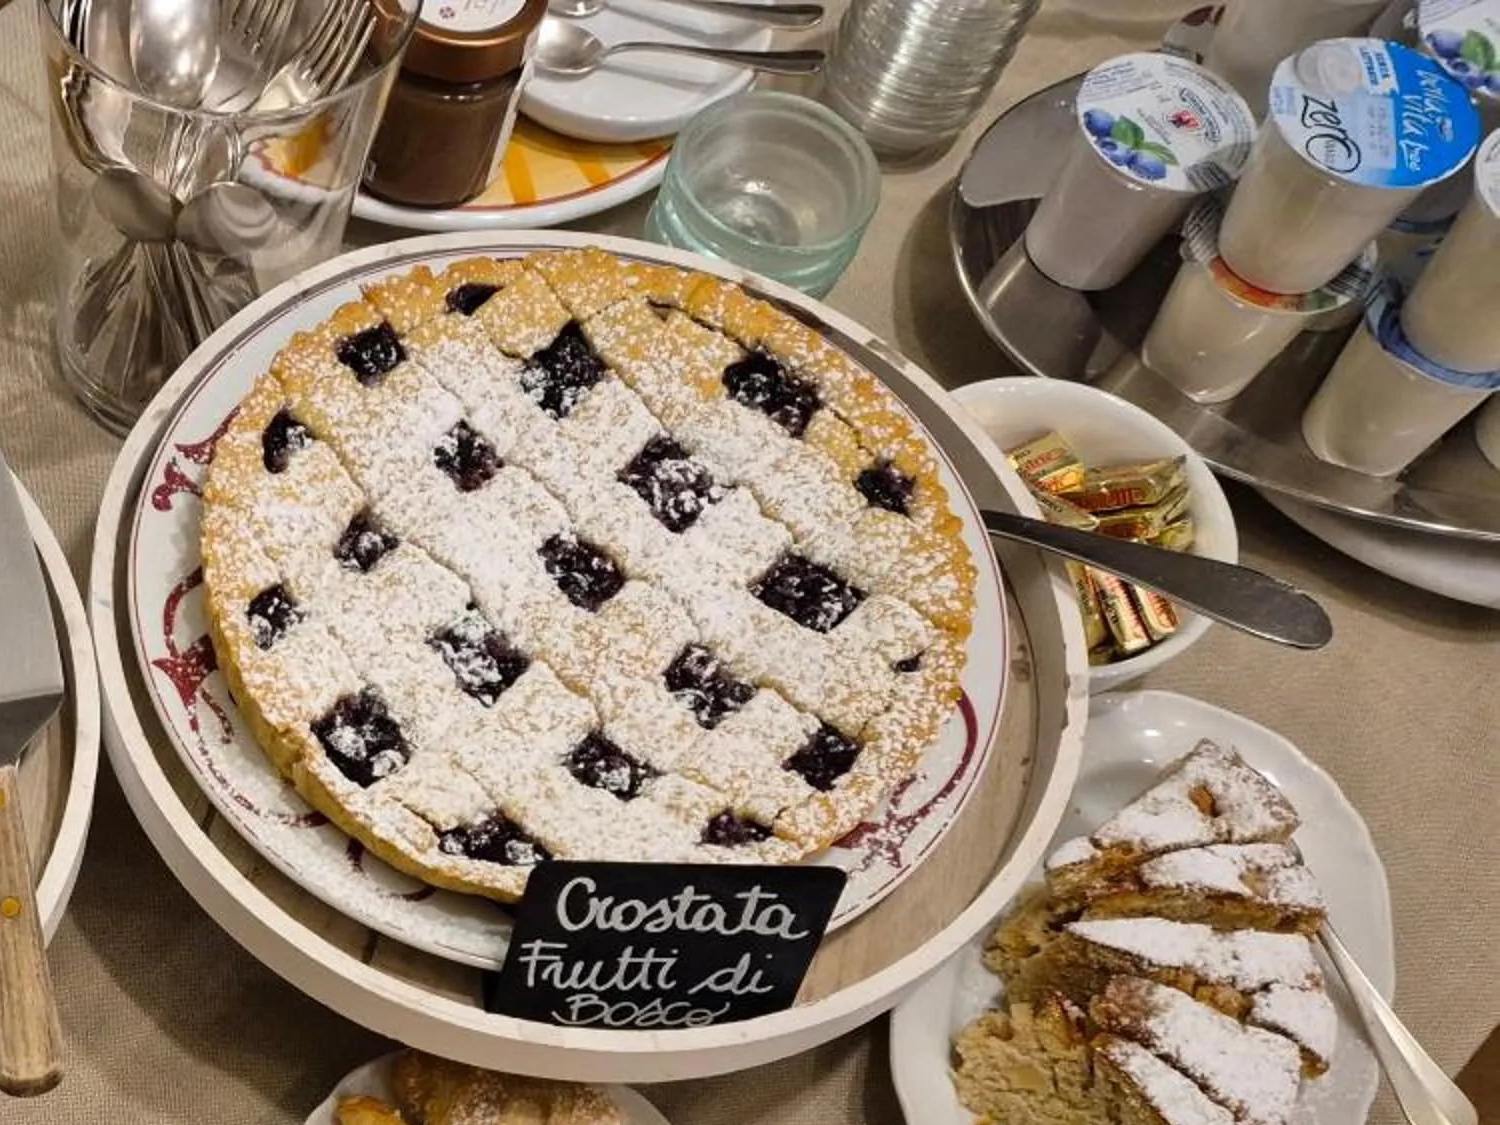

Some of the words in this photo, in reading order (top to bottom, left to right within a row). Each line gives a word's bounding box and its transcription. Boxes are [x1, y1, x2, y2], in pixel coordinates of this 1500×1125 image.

[556, 876, 810, 940] Crostata
[518, 938, 680, 992] Frutti
[687, 952, 775, 996] di
[550, 993, 731, 1027] Bosco
